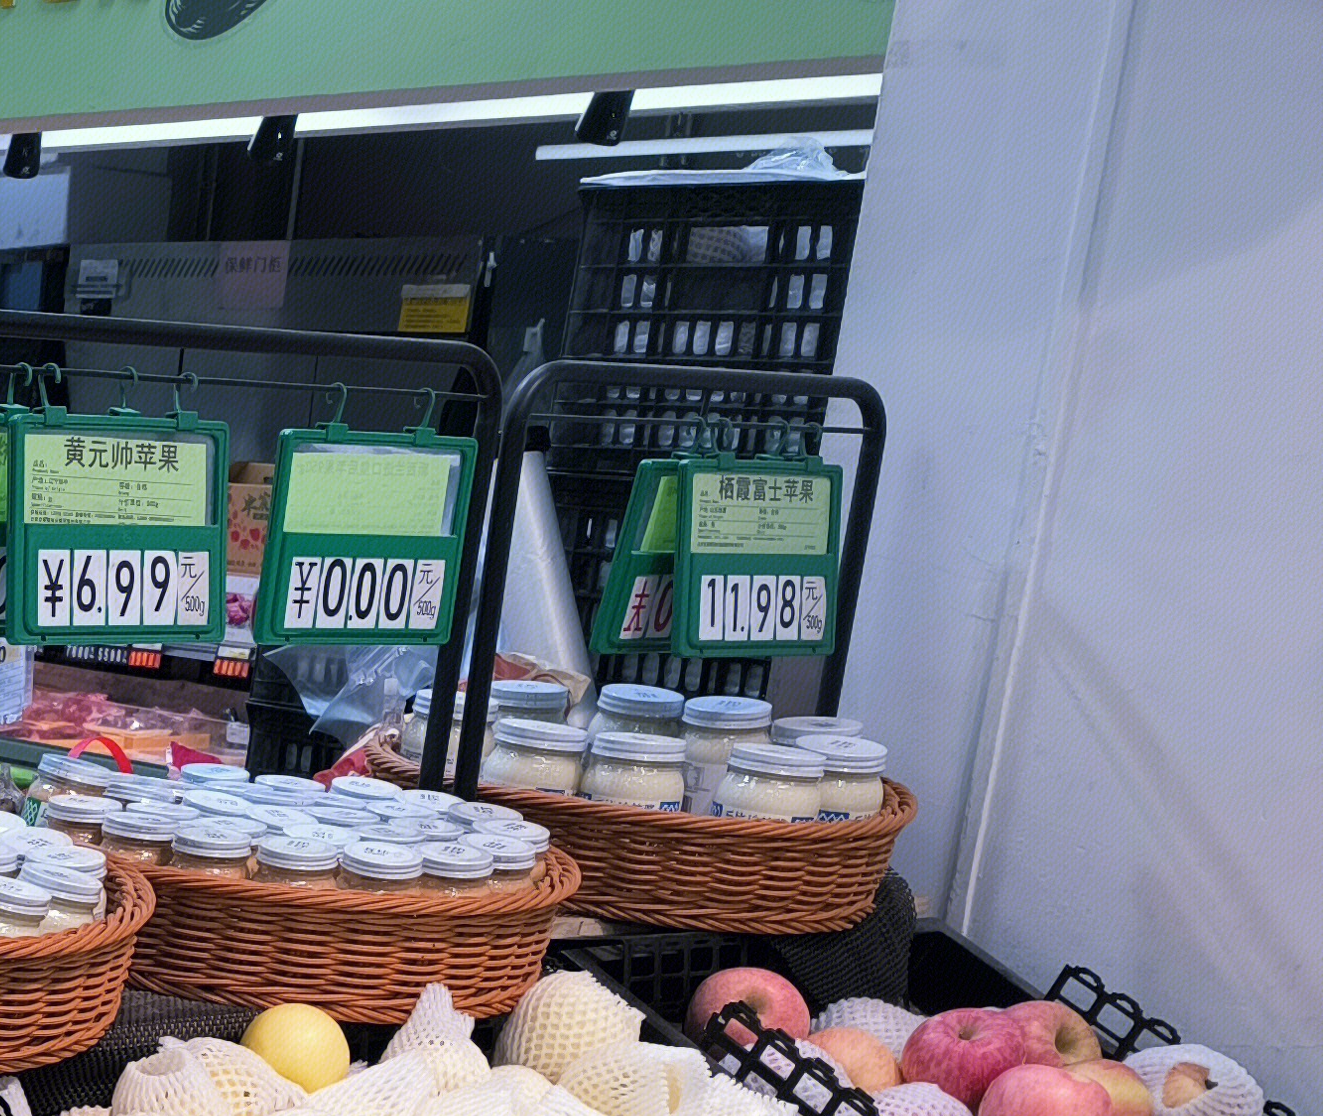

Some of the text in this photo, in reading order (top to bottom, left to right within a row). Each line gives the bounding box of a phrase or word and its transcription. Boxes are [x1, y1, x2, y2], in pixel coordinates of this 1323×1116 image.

[64, 436, 179, 473] 黄元帅苹果
[719, 475, 814, 503] 栖霞富士苹果
[42, 555, 171, 618] ¥6.99
[292, 558, 408, 621] ¥0.00
[707, 578, 796, 633] 11.98
